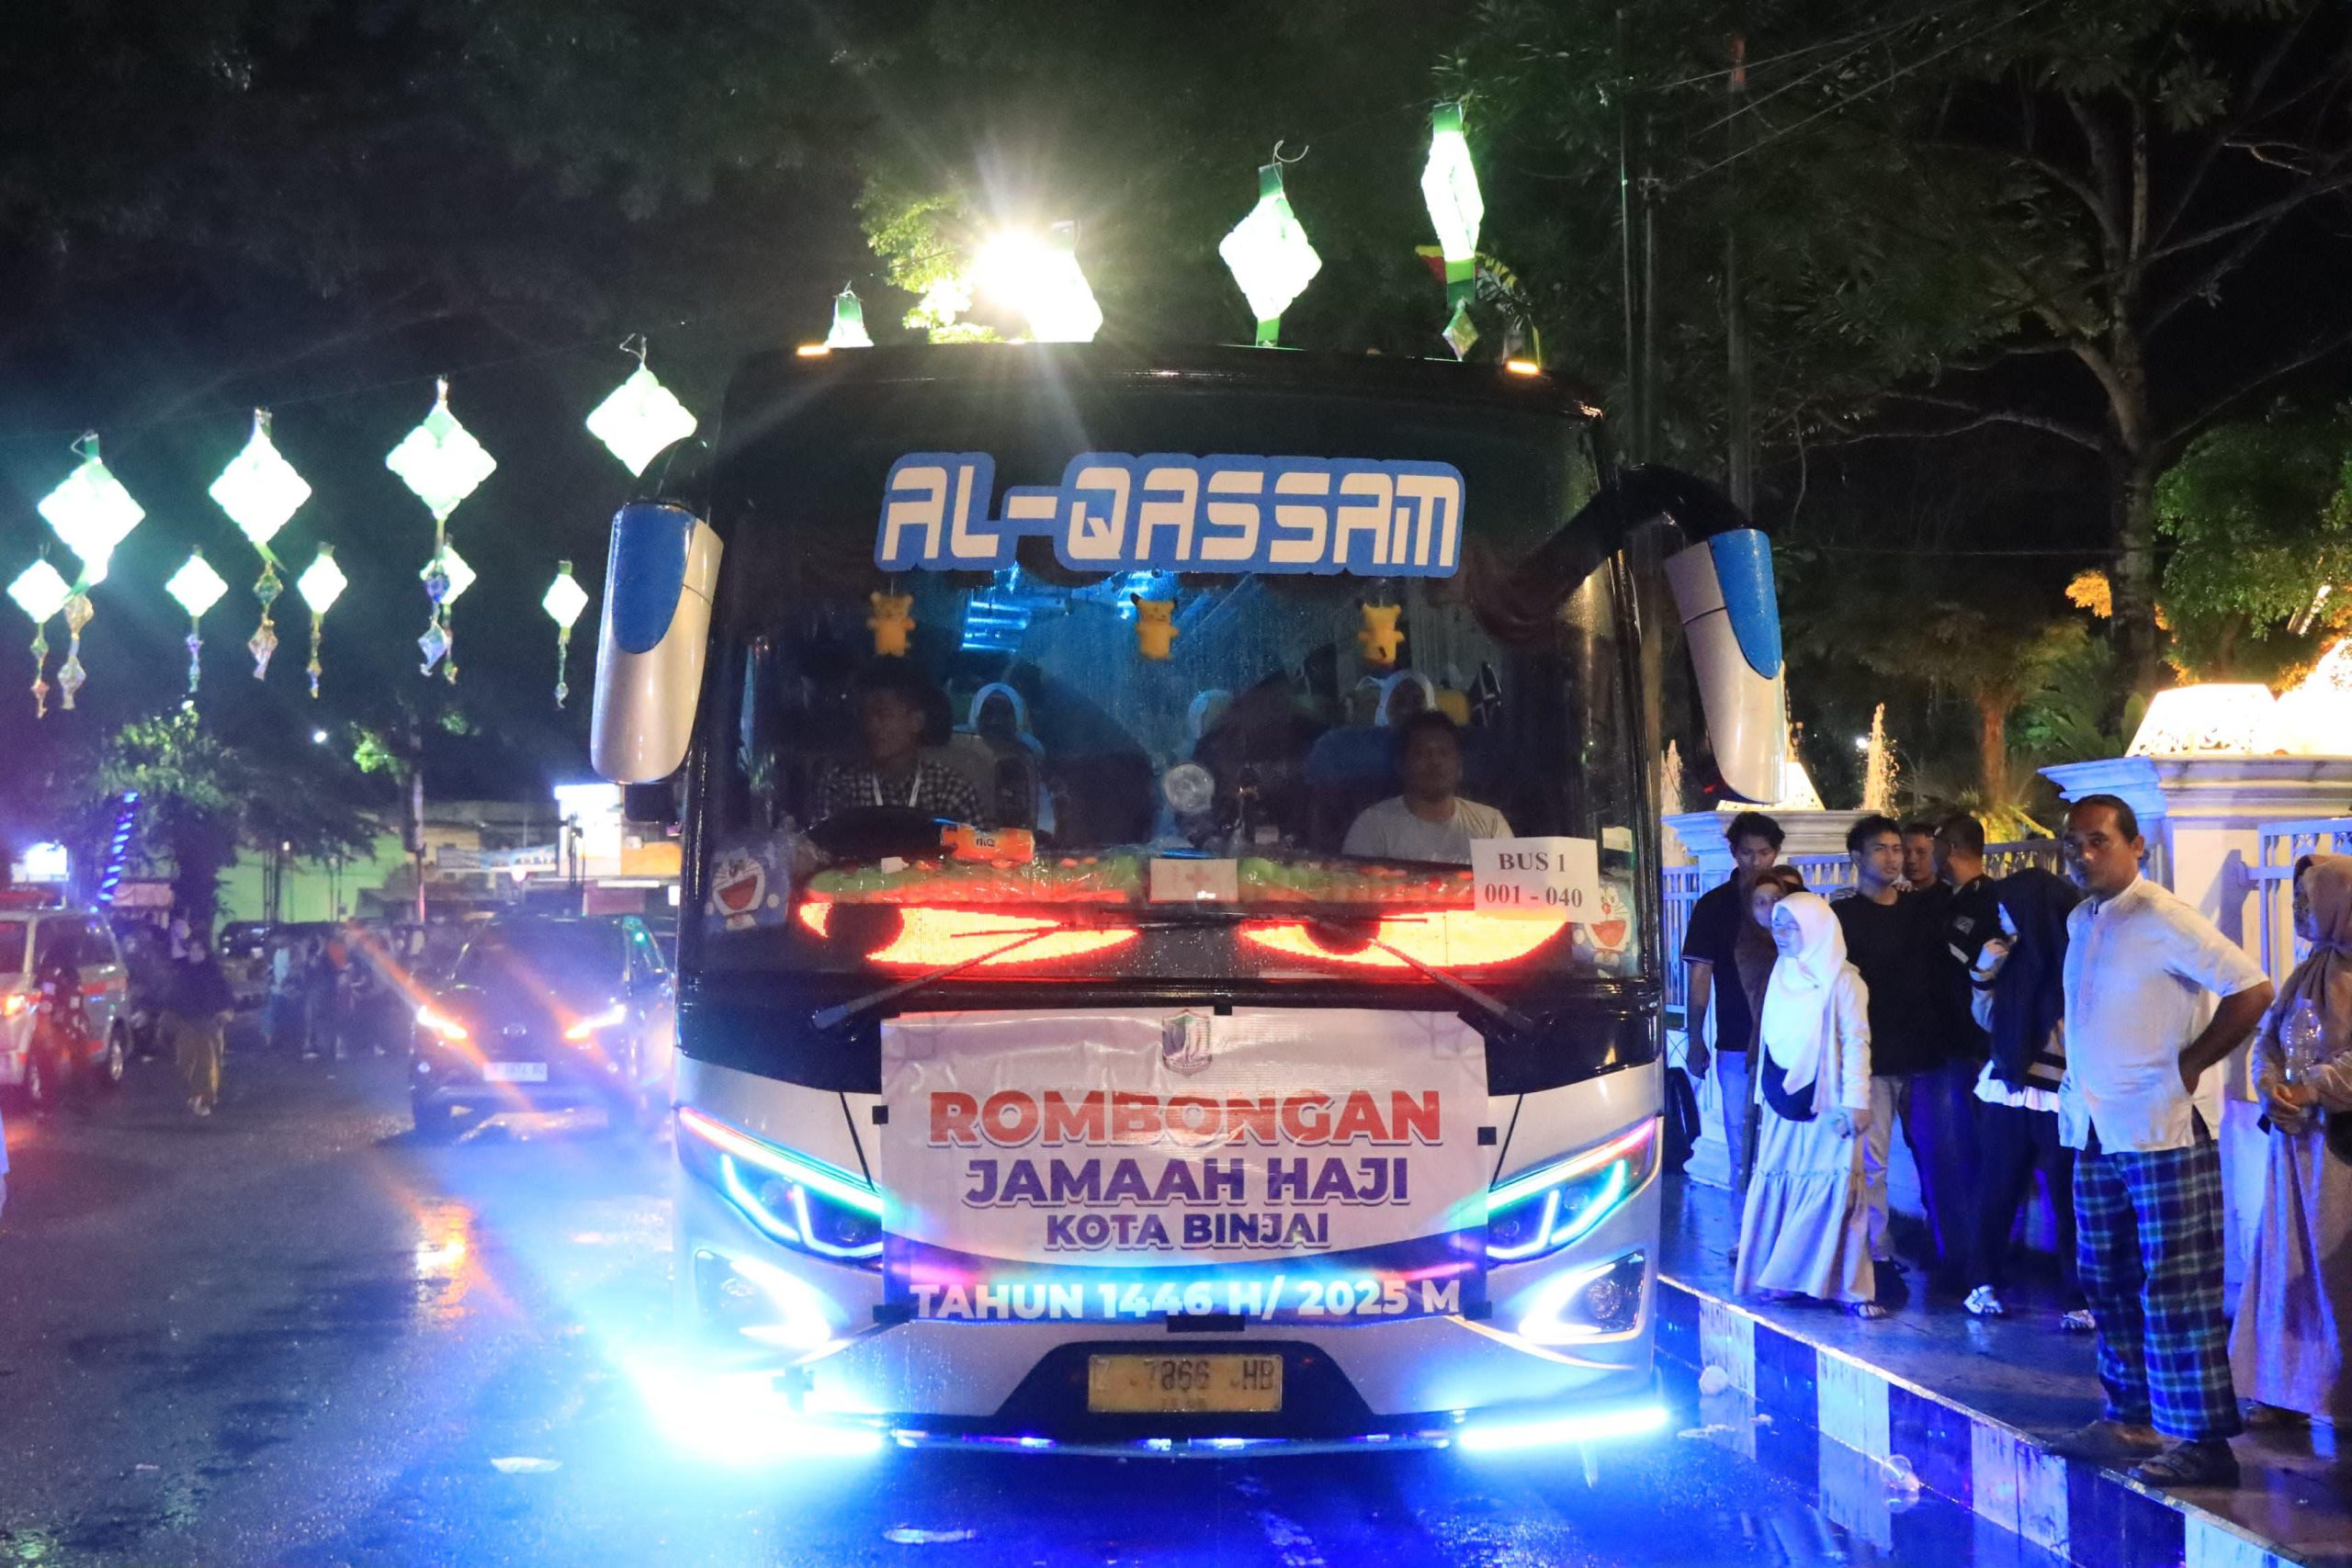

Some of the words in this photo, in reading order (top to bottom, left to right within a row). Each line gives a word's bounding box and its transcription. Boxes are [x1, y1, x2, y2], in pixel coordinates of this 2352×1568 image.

[1498, 852, 1549, 871] BUS
[1557, 854, 1566, 873] 1
[1485, 884, 1521, 904] 001
[1545, 886, 1582, 908] 040
[928, 1089, 1442, 1146] ROMBONGAN
[963, 1158, 1246, 1207] JAMAAH
[1265, 1157, 1409, 1205] HAJI
[1045, 1213, 1172, 1250] KOTA
[1182, 1213, 1330, 1247] BINJAI
[910, 1283, 1084, 1320] TAHUN
[1098, 1281, 1214, 1317] 1446
[1228, 1275, 1285, 1320] H/
[1296, 1280, 1409, 1315] 2025
[1421, 1280, 1460, 1313] M
[1242, 1359, 1275, 1391] HB
